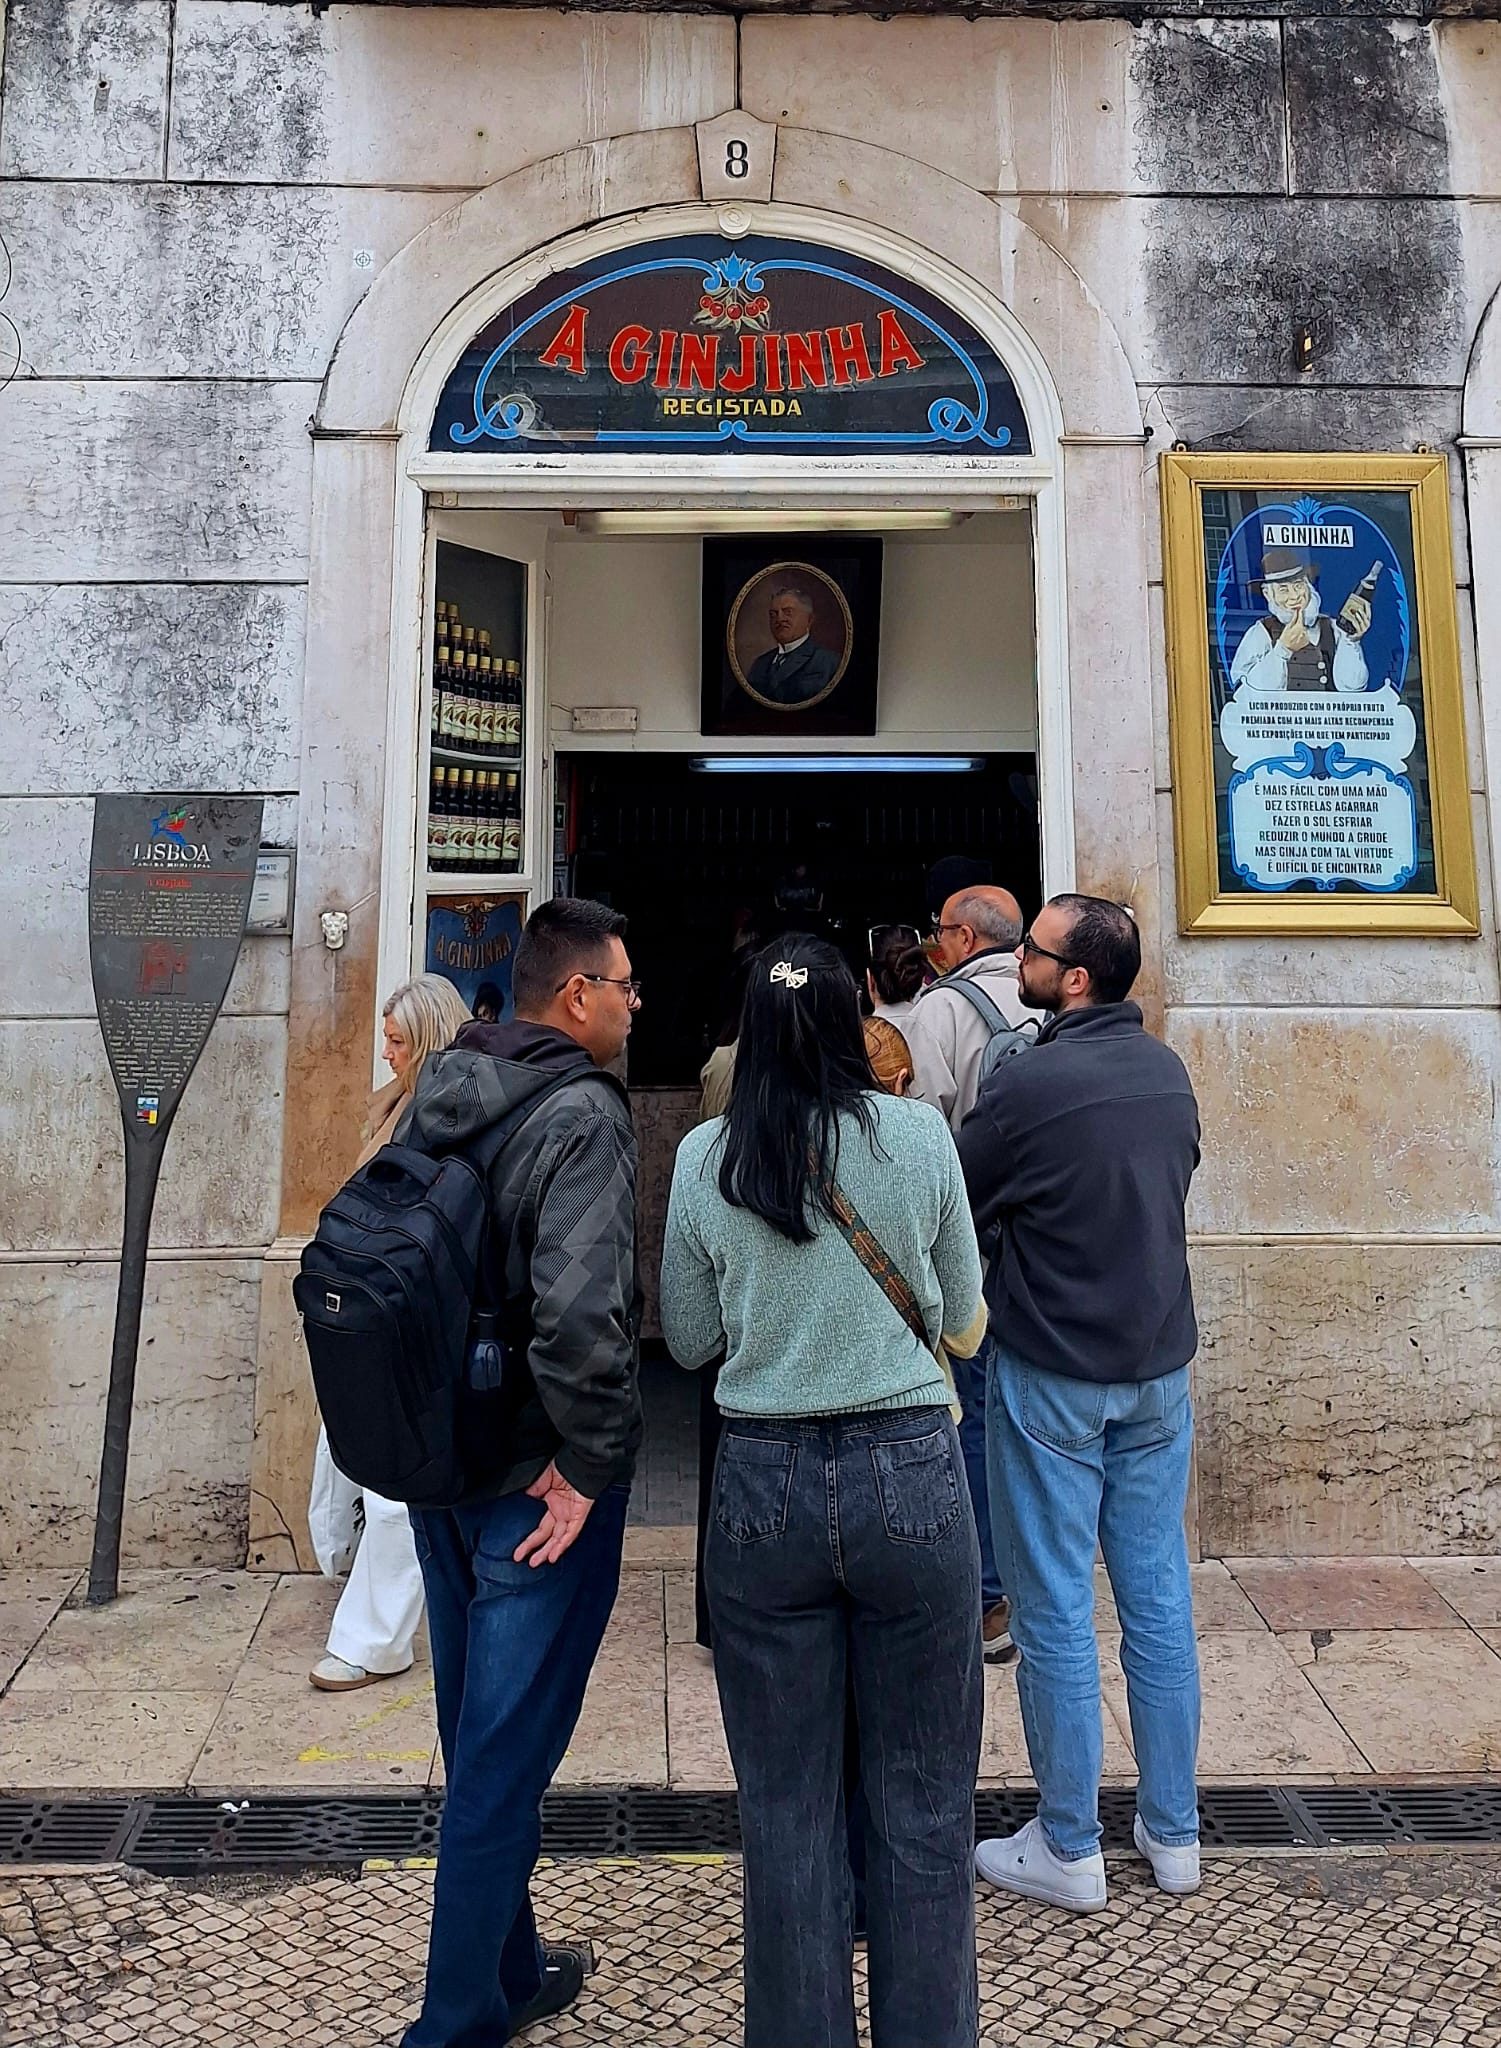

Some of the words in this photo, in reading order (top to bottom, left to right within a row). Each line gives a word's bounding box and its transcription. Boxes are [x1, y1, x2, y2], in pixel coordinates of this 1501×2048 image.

[725, 140, 749, 178] 8
[538, 304, 591, 375] A
[608, 308, 927, 392] GINJINHA
[663, 397, 802, 416] REGISTADA
[1266, 526, 1275, 544] A
[1281, 526, 1350, 547] GINJINHA
[1249, 702, 1269, 711] LICOR
[1270, 702, 1308, 711] PRODUZIDO
[1310, 702, 1325, 711] COM
[1326, 703, 1331, 711] O
[1332, 702, 1362, 712] PRÓPRIO
[1363, 703, 1385, 712] FRUTO
[1241, 716, 1276, 724] PREMIADA
[1277, 716, 1293, 725] COM
[1294, 716, 1303, 725] AS
[1304, 716, 1322, 725] MAIS
[1323, 717, 1343, 725] ALTAS
[1345, 717, 1394, 726] RECOMPENSAS
[1247, 730, 1260, 738] NAS
[1262, 729, 1303, 740] EXPOSIÇÕES
[1304, 730, 1315, 739] EM
[1316, 731, 1330, 739] QUE
[1331, 731, 1345, 740] TEM
[1346, 731, 1390, 740] PARTICIPADO
[1254, 784, 1260, 795] É
[1263, 785, 1288, 796] MAIS
[1290, 783, 1315, 796] FÁCIL
[1318, 786, 1339, 797] COM
[1342, 786, 1364, 797] UMA
[1366, 784, 1388, 797] MÃO
[1265, 800, 1282, 811] DEZ
[1285, 801, 1332, 812] ESTRELAS
[1335, 801, 1379, 812] AGARRAR
[1273, 816, 1301, 827] FAZER
[1304, 816, 1309, 827] O
[1313, 816, 1330, 827] SOL
[1333, 817, 1373, 828] ESFRIAR
[1259, 831, 1298, 842] REDUZIR
[1301, 831, 1307, 842] O
[1311, 832, 1345, 842] MUNDO
[1348, 832, 1354, 843] A
[1357, 832, 1388, 843] GRUDE
[133, 843, 211, 861] LISBOA
[1255, 846, 1276, 857] MAS
[1279, 847, 1307, 858] GINJA
[1311, 847, 1332, 858] COM
[1335, 847, 1351, 858] TAL
[1354, 848, 1394, 859] VIRTUDE
[1268, 859, 1273, 872] É
[1276, 861, 1308, 873] DIFÍCIL
[1311, 863, 1323, 873] DE
[1326, 863, 1382, 874] ENCONTRAR
